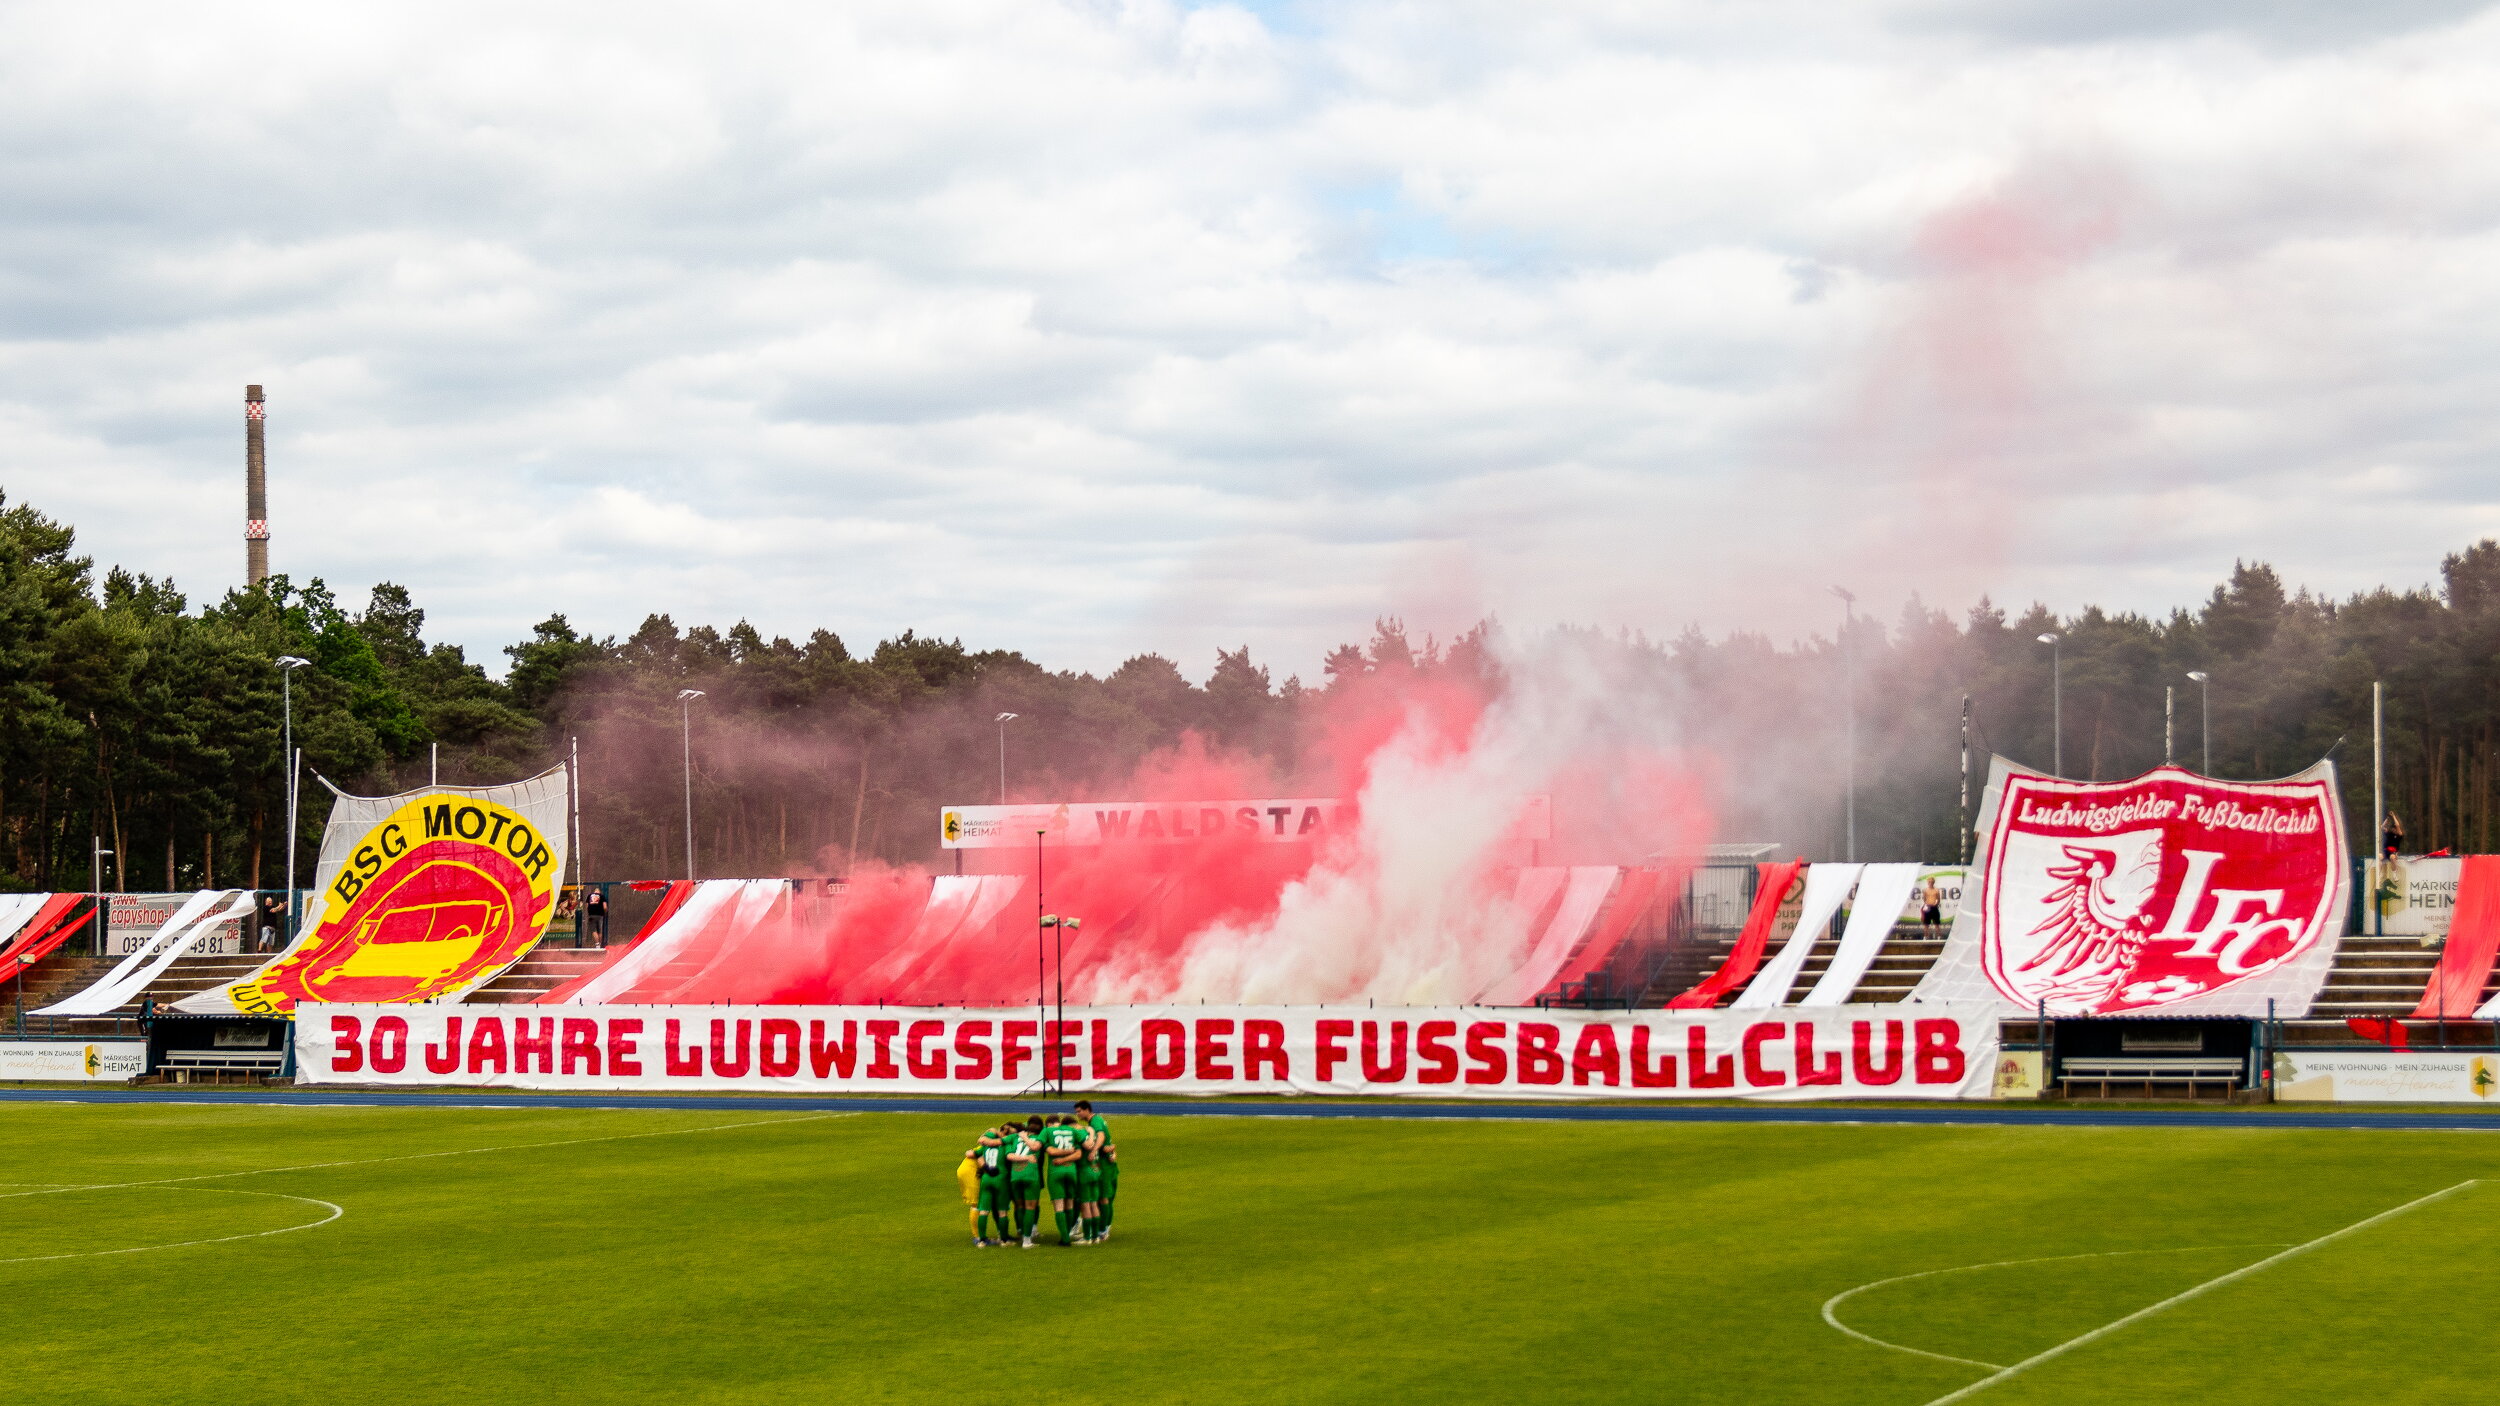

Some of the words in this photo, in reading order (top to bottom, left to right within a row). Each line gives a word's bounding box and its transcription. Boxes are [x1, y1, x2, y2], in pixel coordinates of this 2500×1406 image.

[2018, 793, 2174, 832] Ludwigsfelder
[2178, 794, 2320, 834] Fußballclub
[963, 827, 1002, 837] HEIMAT
[335, 824, 408, 904] BSG
[424, 803, 550, 882] MOTOR
[2150, 849, 2305, 975] LFC
[209, 937, 223, 953] 81
[103, 1053, 142, 1062] MÄRKISCHE
[330, 1015, 409, 1075] 30
[425, 1016, 644, 1077] JAHRE
[664, 1018, 1290, 1083] LUDWIGSFELDER
[1315, 1017, 1966, 1089] FUSSBALLCLUB
[103, 1062, 142, 1072] HEIMAT
[2306, 1063, 2334, 1071] MEINE
[2337, 1063, 2387, 1072] WOHNUNG
[2395, 1063, 2418, 1072] MEIN
[2420, 1063, 2466, 1072] ZUHAUSE
